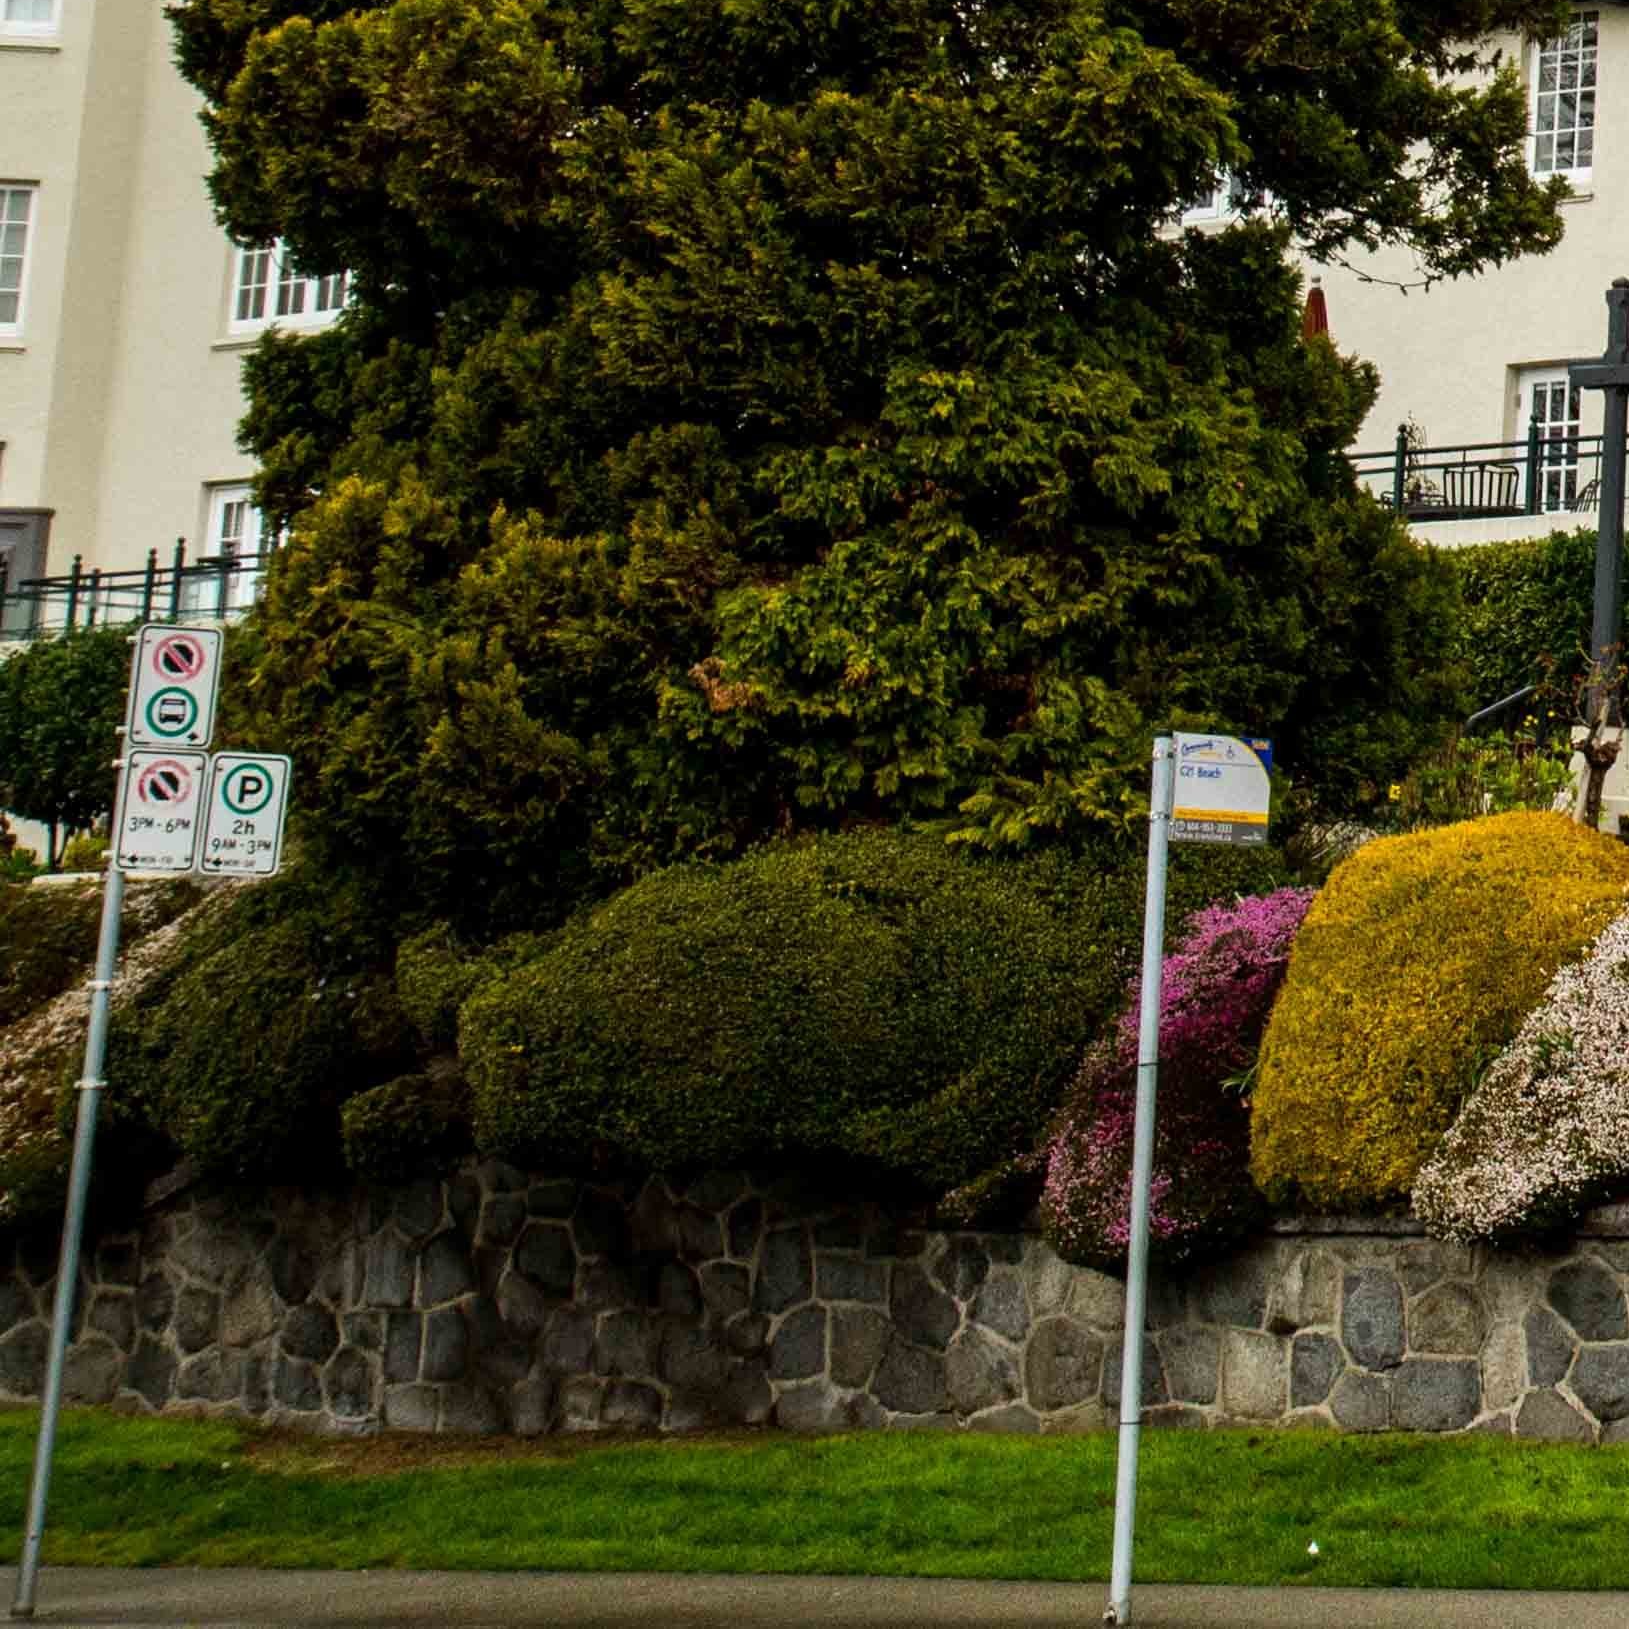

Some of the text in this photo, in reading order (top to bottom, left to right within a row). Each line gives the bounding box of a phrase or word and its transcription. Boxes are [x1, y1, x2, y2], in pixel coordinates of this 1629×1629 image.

[1197, 767, 1222, 778] Beach
[239, 776, 263, 803] P
[128, 817, 153, 833] 3PM
[165, 818, 191, 833] 6PM
[232, 820, 255, 835] 2h
[211, 838, 236, 852] 9AM
[247, 840, 271, 854] 3PM
